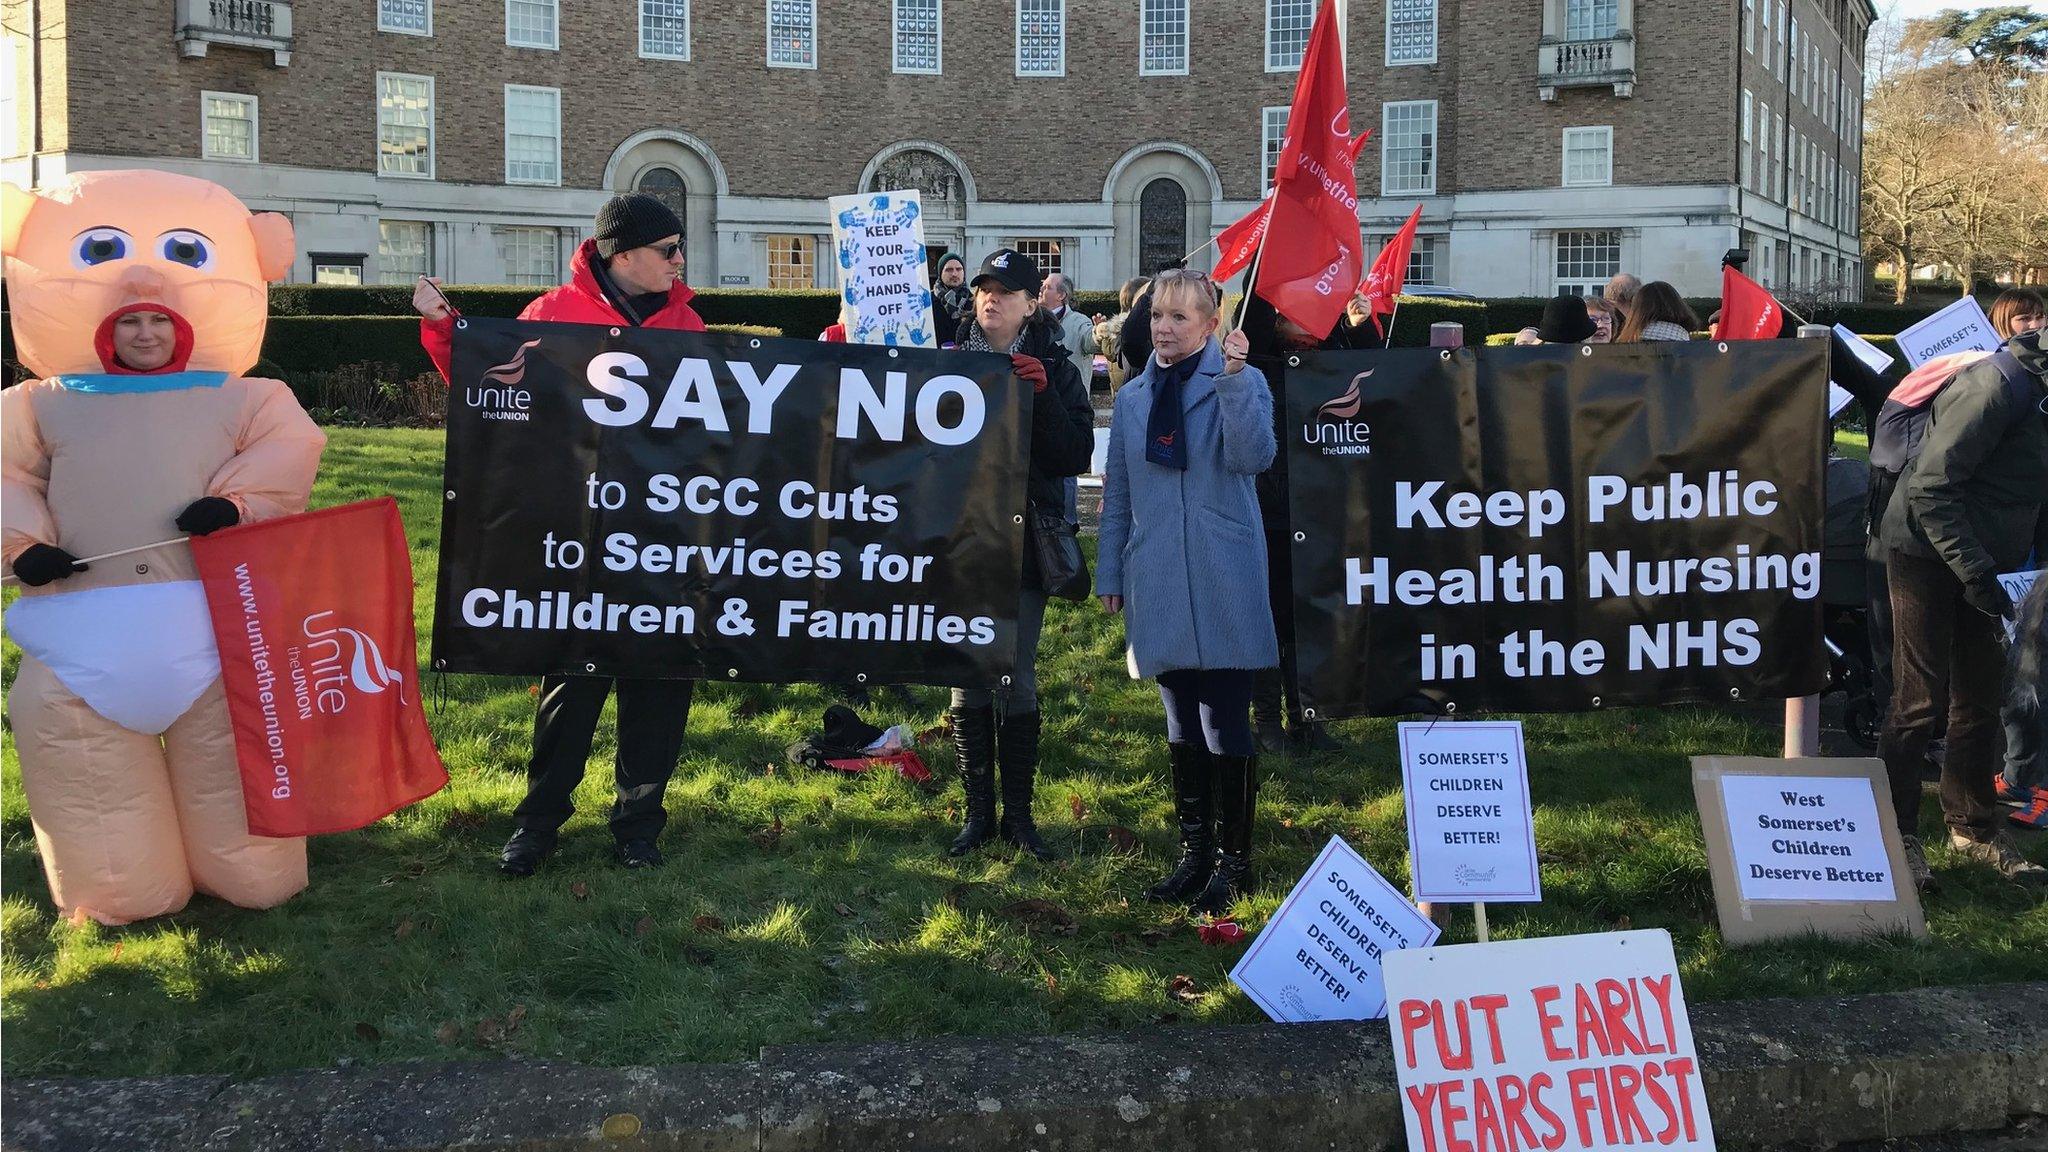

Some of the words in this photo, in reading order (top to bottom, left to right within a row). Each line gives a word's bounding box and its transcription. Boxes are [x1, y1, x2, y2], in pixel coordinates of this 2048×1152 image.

[865, 225, 899, 238] KEEP
[867, 243, 904, 257] YOUR
[868, 264, 903, 277] TORY
[866, 283, 911, 297] HANDS
[878, 303, 903, 316] OFF
[1919, 323, 1980, 361] SOMERSET'S
[466, 386, 531, 409] unite
[582, 352, 802, 434] SAY
[838, 367, 987, 447] NO
[1304, 420, 1370, 444] unite
[586, 471, 626, 510] to
[646, 473, 759, 516] SCC
[779, 480, 899, 523] Cuts
[1395, 481, 1566, 538] Keep
[1588, 469, 1778, 523] Public
[543, 532, 585, 570] to
[603, 532, 842, 580] Services
[861, 543, 934, 583] for
[1345, 553, 1565, 606] Health
[1588, 545, 1821, 600] Nursing
[461, 588, 695, 634] Children
[715, 598, 756, 637] &
[777, 600, 996, 646] Families
[303, 610, 346, 715] unite
[1421, 634, 1476, 681] in
[1500, 629, 1605, 678] the
[1628, 618, 1762, 672] NHS
[234, 562, 291, 801] www.unitetheunion.org
[1418, 752, 1509, 766] SOMERSET'S
[1429, 778, 1504, 791] CHILDREN
[1780, 791, 1825, 807] West
[1437, 805, 1502, 818] DESERVE
[1758, 814, 1856, 832] Somerset's
[1443, 831, 1501, 845] BETTER!
[1771, 839, 1852, 856] Children
[1750, 864, 1822, 882] Deserve
[1825, 867, 1884, 883] Better
[1328, 871, 1409, 950] SOMERSET'S
[1319, 899, 1384, 965] CHILDREN
[1306, 923, 1368, 984] DESERVE
[1295, 947, 1352, 1004] BETTER!
[1399, 994, 1509, 1070] PUT
[1531, 974, 1678, 1061] EARLY
[1406, 1072, 1567, 1152] YEARS
[1567, 1058, 1699, 1150] FIRST
